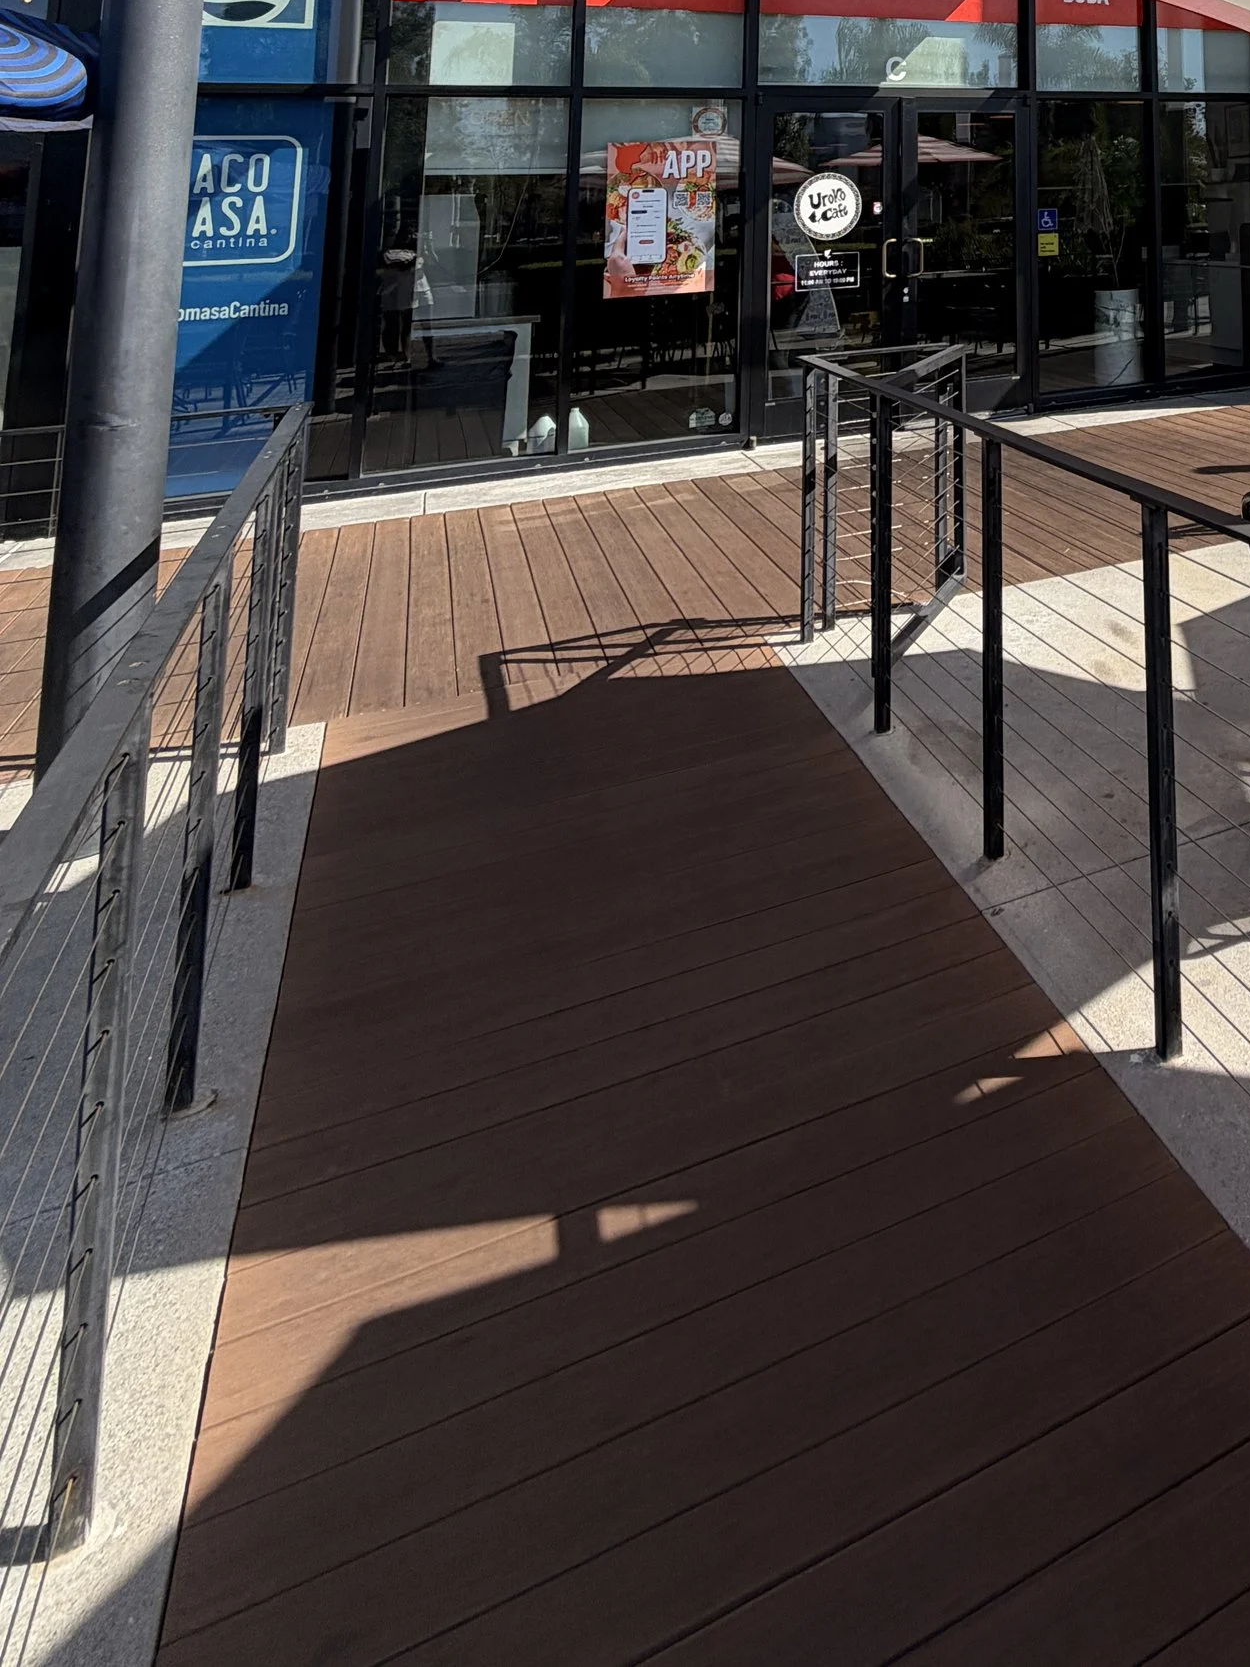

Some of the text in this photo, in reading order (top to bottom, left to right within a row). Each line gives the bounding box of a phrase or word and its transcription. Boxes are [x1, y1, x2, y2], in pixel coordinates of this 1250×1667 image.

[886, 56, 907, 81] C
[193, 154, 270, 193] ACO
[663, 150, 712, 179] APP
[192, 195, 277, 237] ASA.
[821, 203, 848, 222] Cafe
[190, 237, 268, 249] cantina
[809, 268, 847, 277] EVERYDAY
[814, 260, 839, 268] HOURS
[178, 300, 289, 322] omasaCantina
